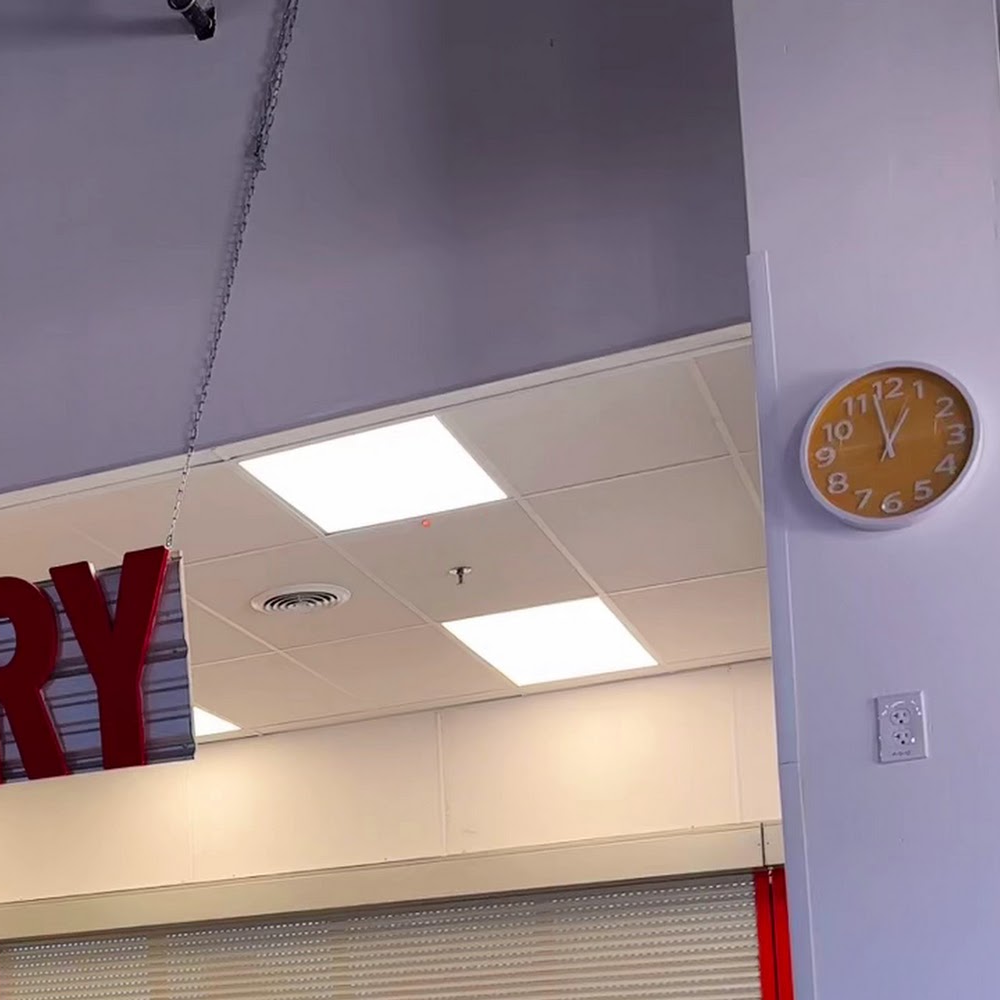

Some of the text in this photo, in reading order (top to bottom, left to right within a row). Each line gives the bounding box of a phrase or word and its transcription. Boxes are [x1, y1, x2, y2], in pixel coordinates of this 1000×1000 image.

[872, 377, 904, 400] 12
[912, 380, 924, 399] 1
[843, 394, 867, 416] 11
[934, 396, 954, 419] 2
[822, 420, 853, 442] 10
[946, 423, 967, 445] 3
[815, 447, 836, 468] 9
[934, 453, 957, 475] 4
[827, 472, 849, 494] 8
[914, 479, 933, 500] 5
[855, 488, 873, 509] 7
[881, 491, 902, 514] 6
